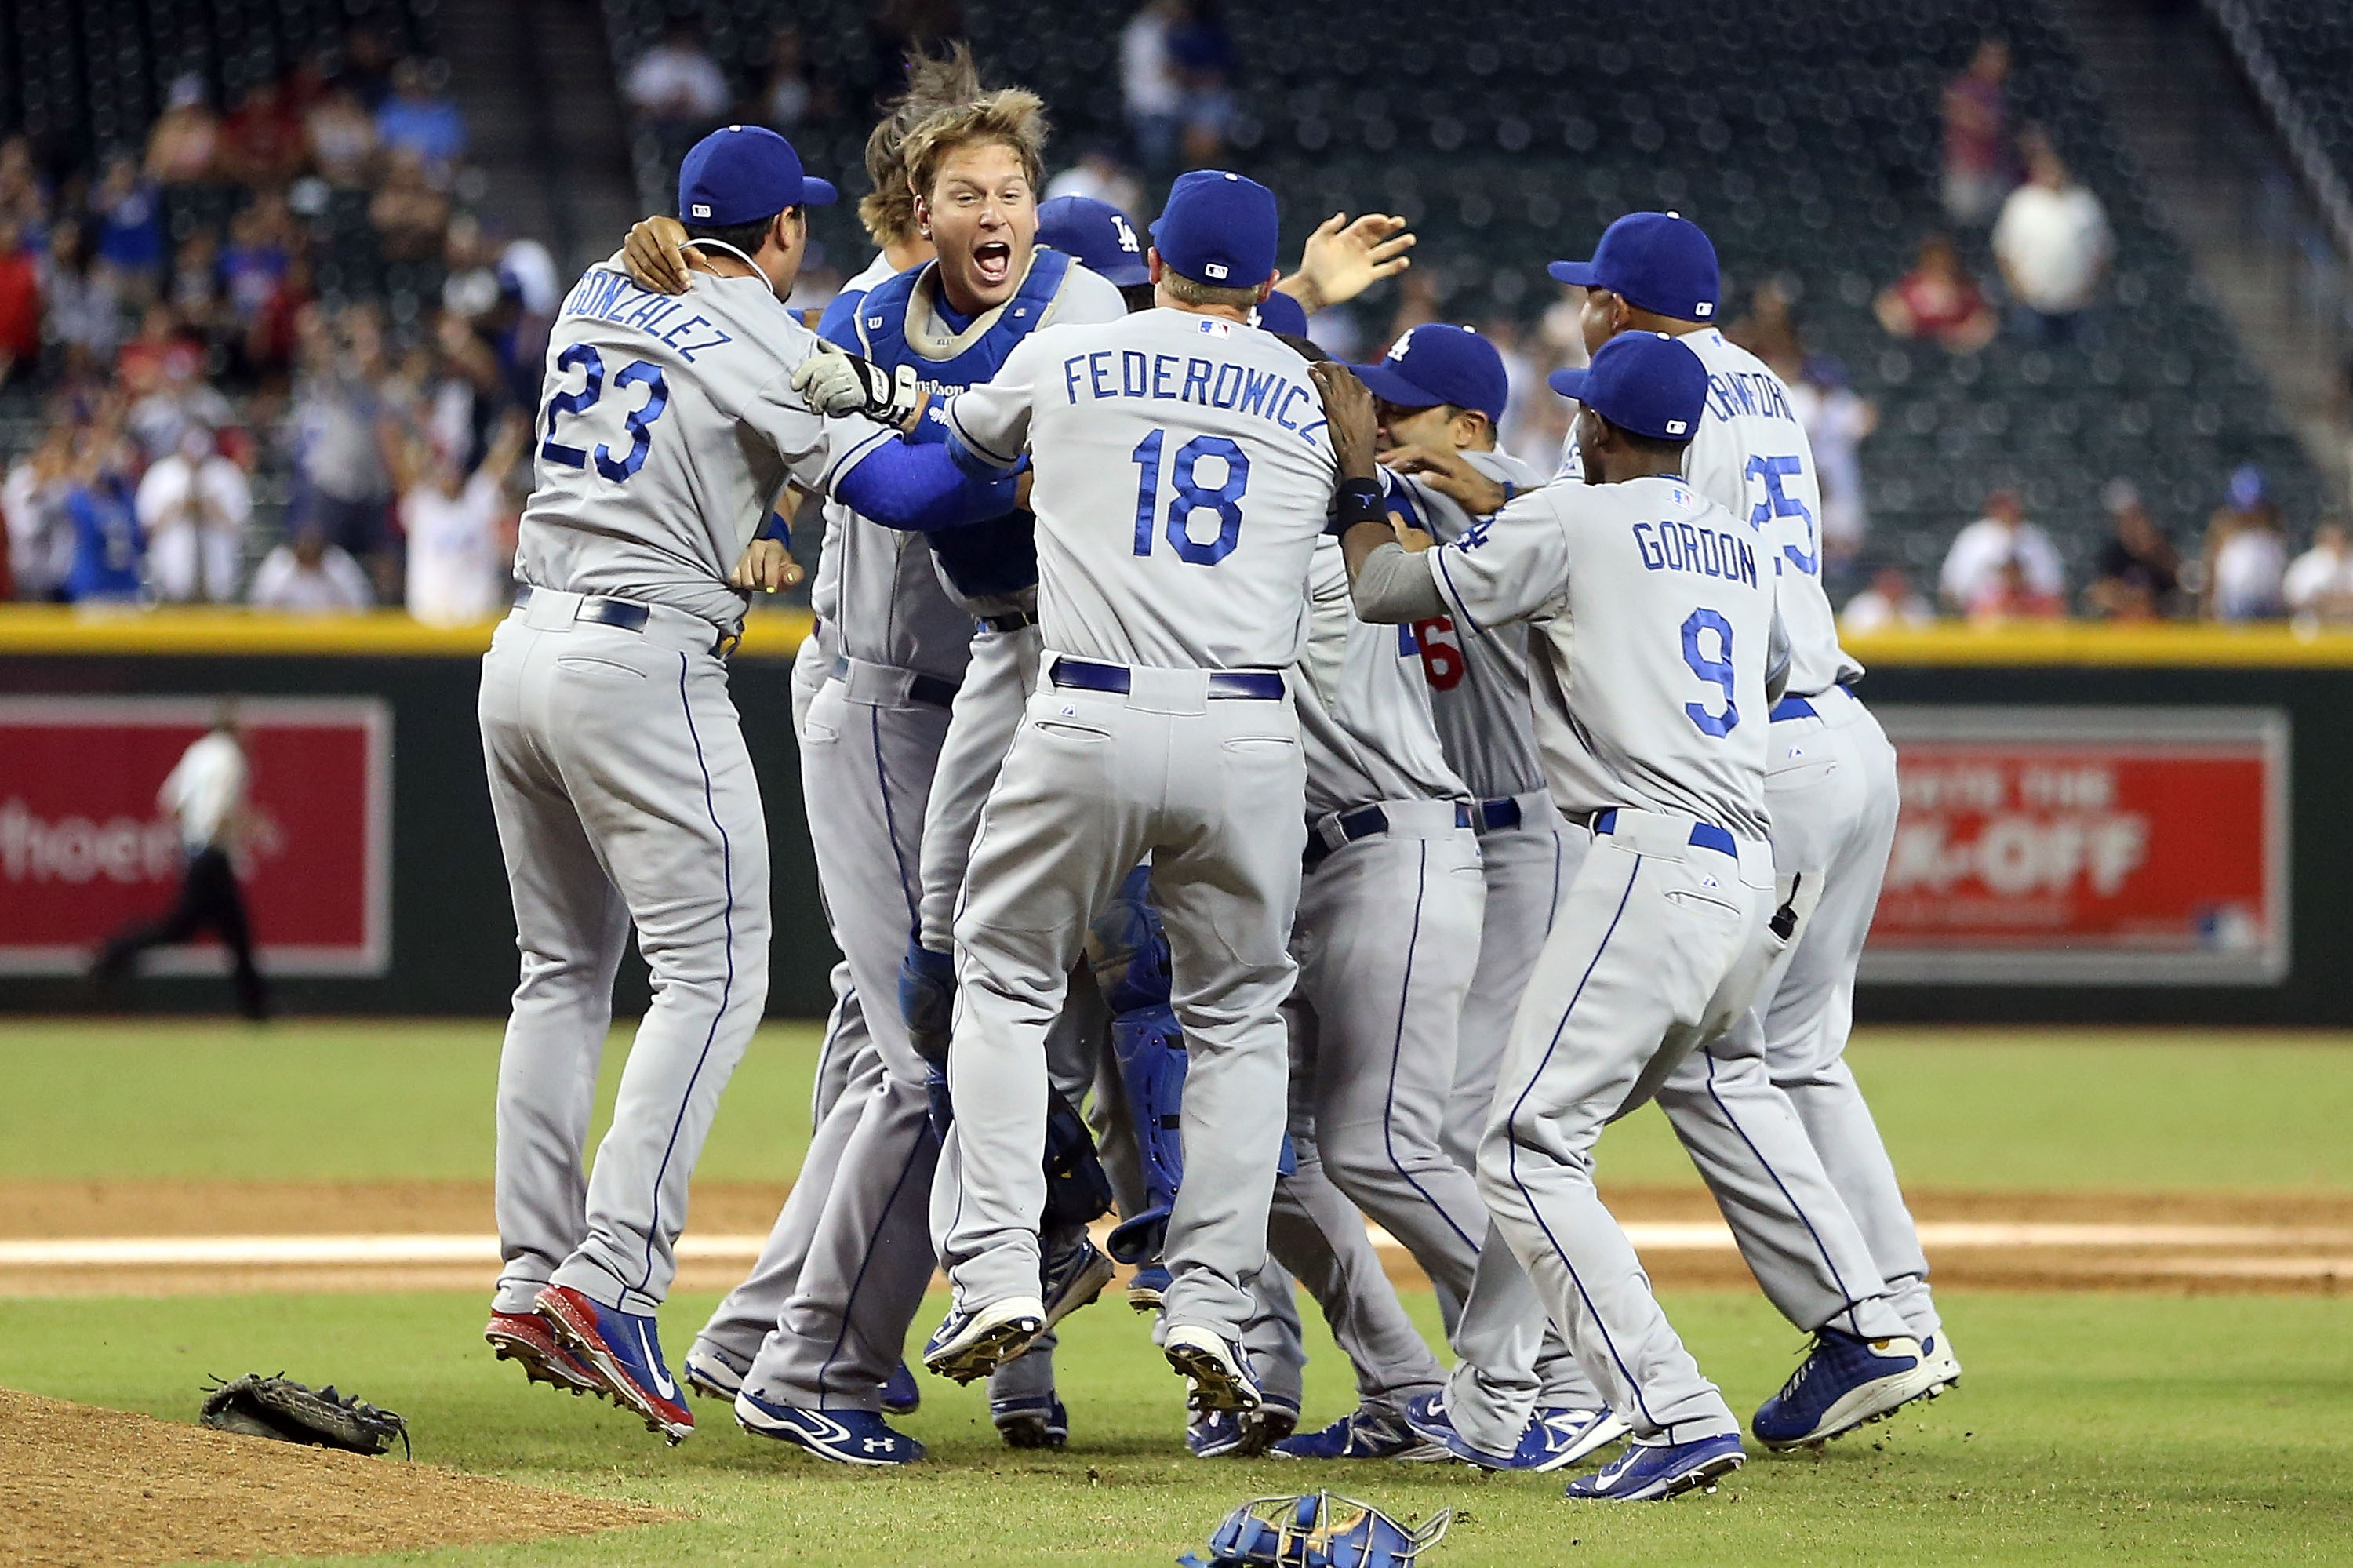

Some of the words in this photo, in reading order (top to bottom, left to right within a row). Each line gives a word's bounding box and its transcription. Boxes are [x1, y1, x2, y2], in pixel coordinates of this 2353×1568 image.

[1110, 216, 1140, 252] LA
[566, 271, 733, 364] GONZALEZ
[541, 343, 669, 483] 23
[1064, 350, 1328, 446] FEDEROWICZ
[1132, 429, 1251, 567] 18
[1745, 455, 1818, 576] 25
[1633, 521, 1758, 590] GORDON
[1413, 616, 1465, 692] 6
[1681, 607, 1740, 739] 9
